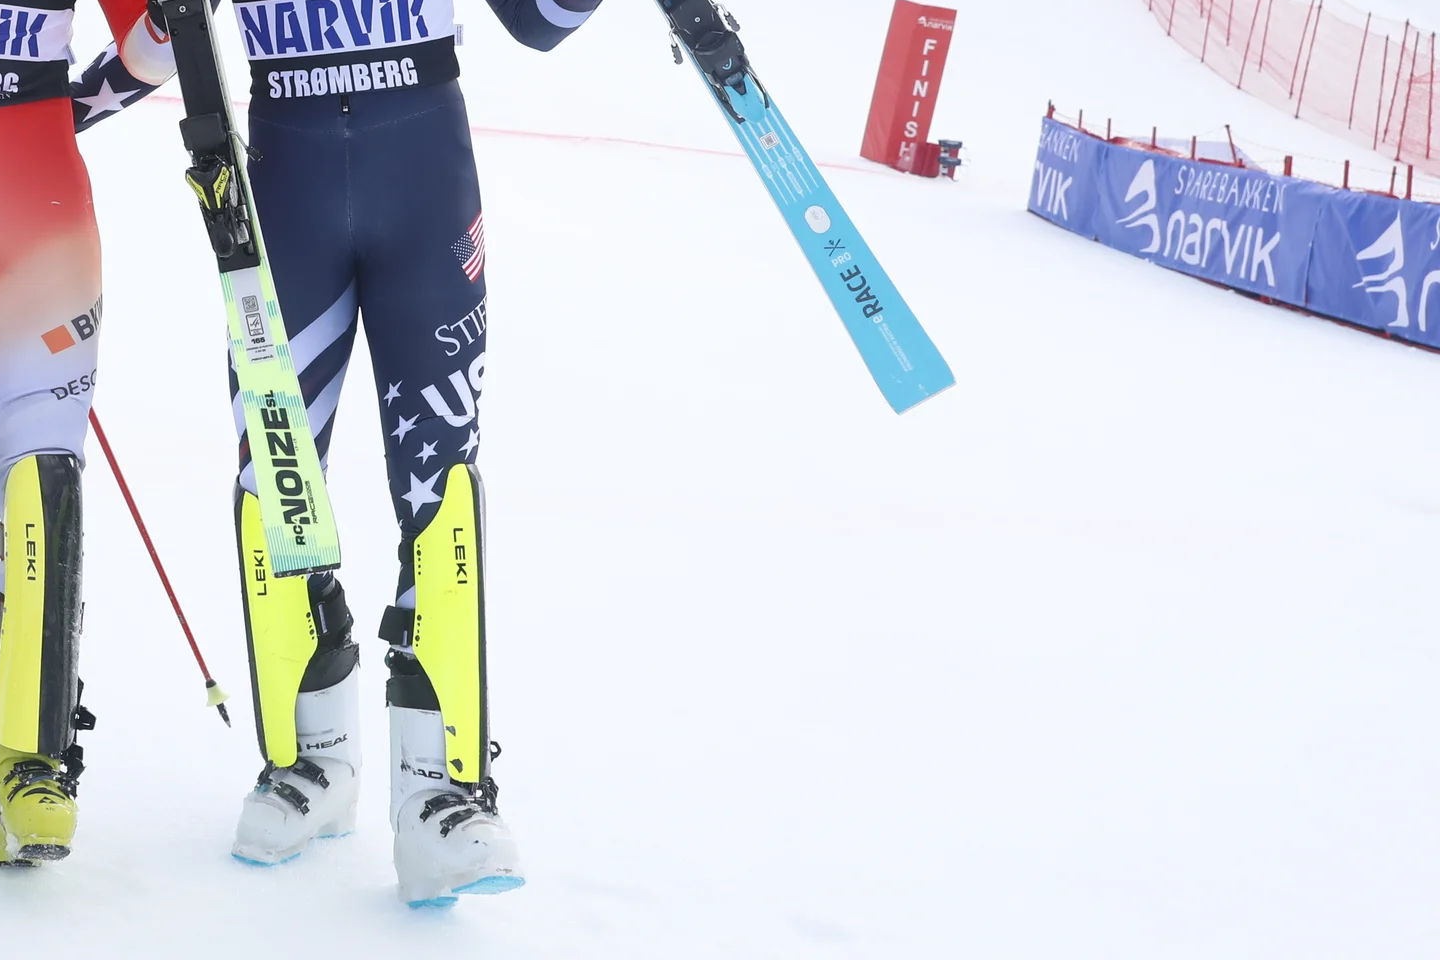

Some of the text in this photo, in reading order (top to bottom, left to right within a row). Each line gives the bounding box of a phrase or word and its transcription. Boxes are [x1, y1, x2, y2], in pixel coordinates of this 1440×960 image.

[268, 57, 419, 99] STRØMBERG
[899, 38, 938, 159] FINISH
[1174, 165, 1287, 214] SPAREBANKEN
[831, 251, 852, 268] PRO
[1163, 208, 1282, 287] narvik
[251, 336, 266, 344] 165
[264, 390, 277, 407] SL
[261, 407, 311, 525] NOIZE
[25, 522, 37, 581] LEKI
[253, 548, 268, 596] LEKI
[453, 527, 468, 585] LEKI
